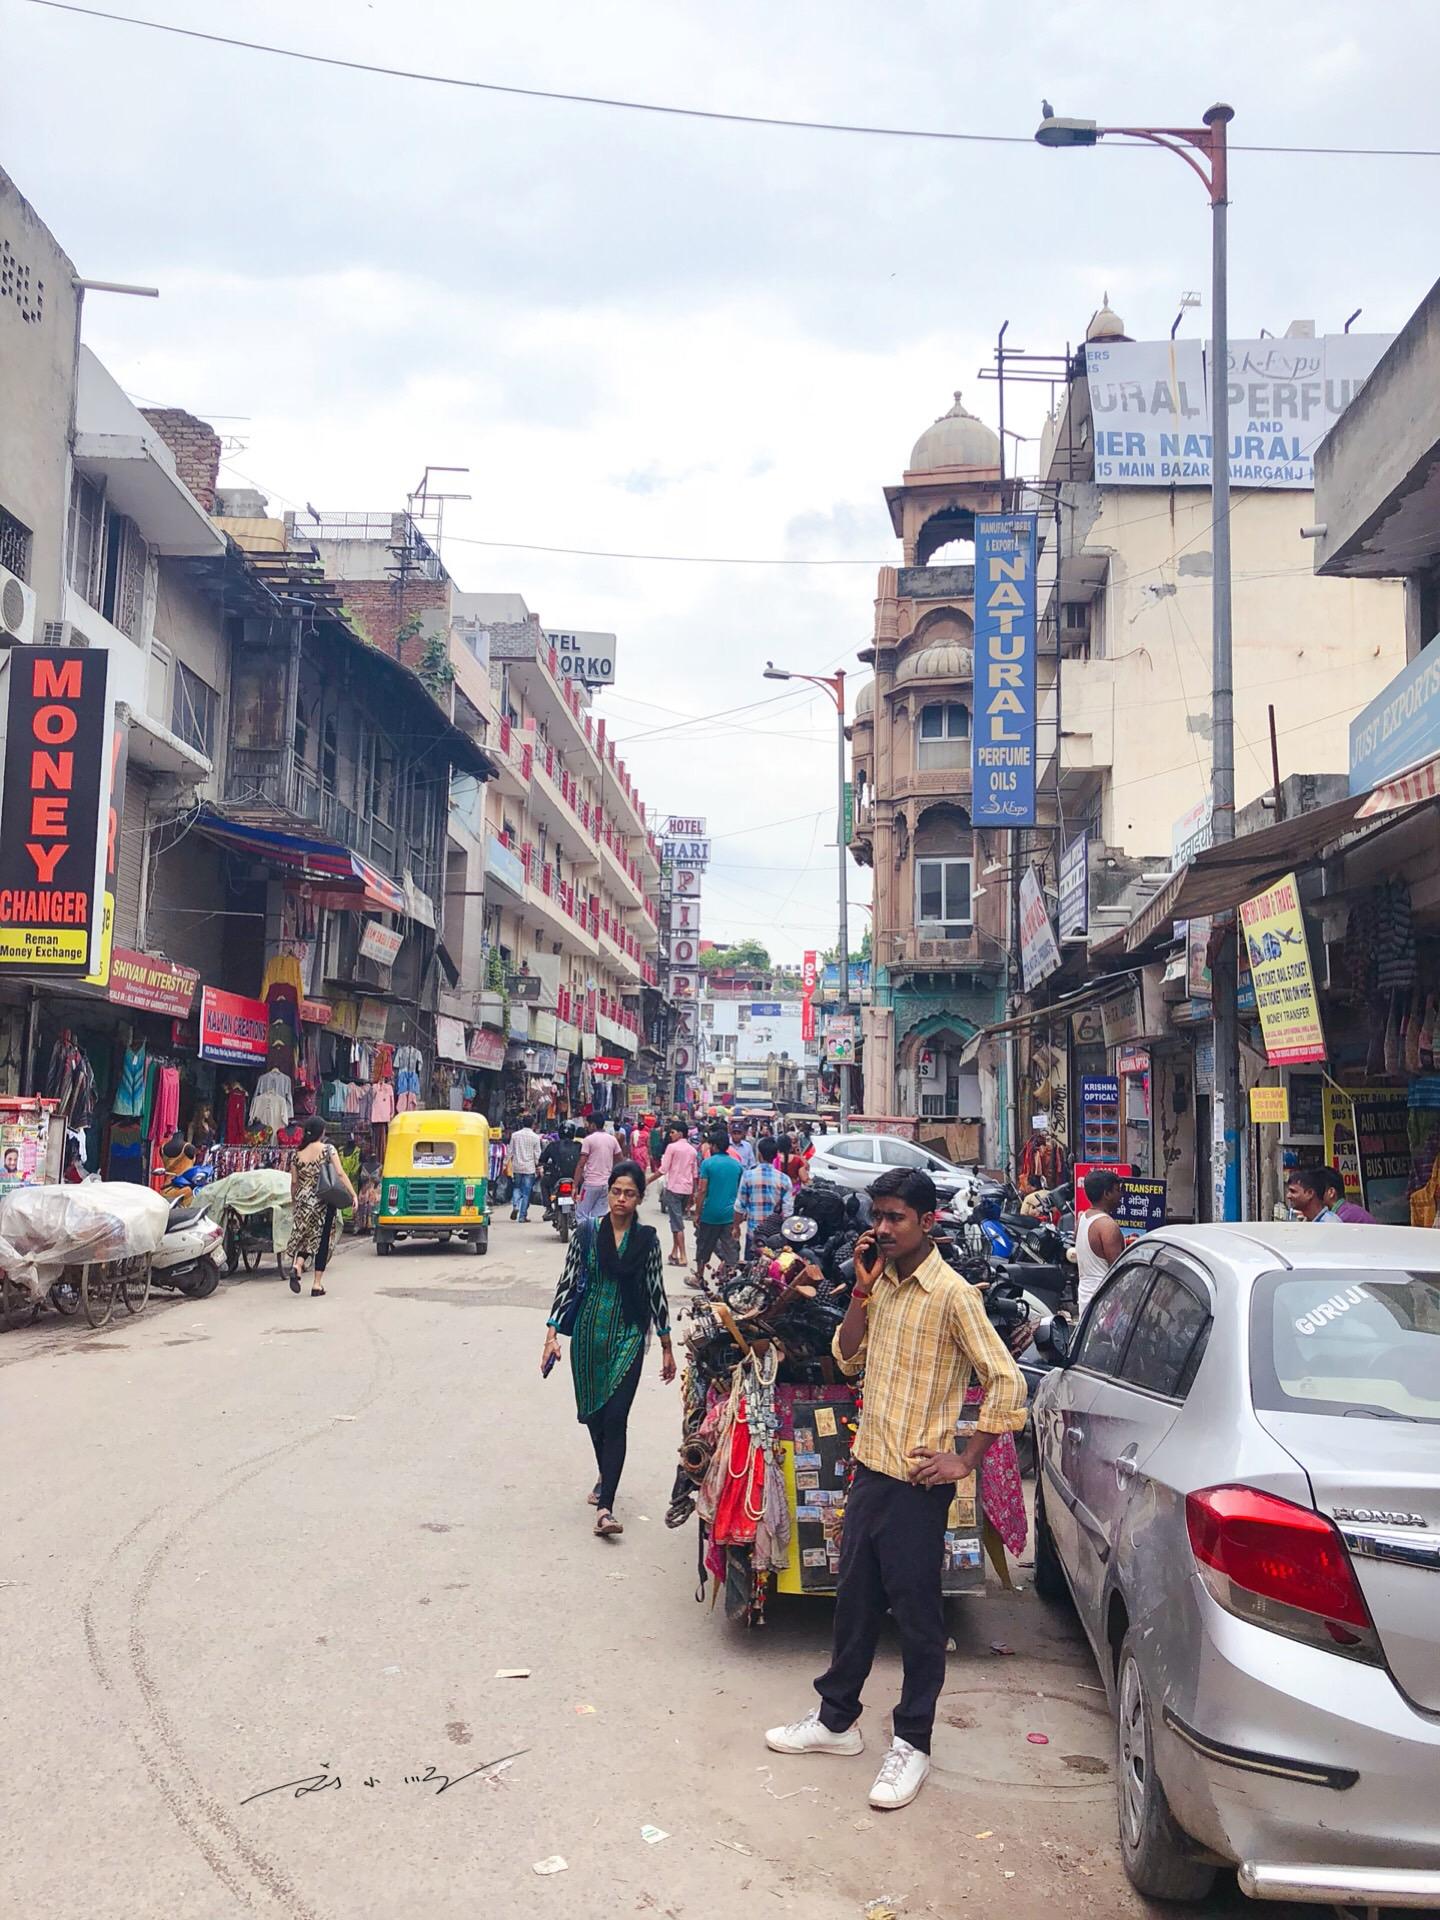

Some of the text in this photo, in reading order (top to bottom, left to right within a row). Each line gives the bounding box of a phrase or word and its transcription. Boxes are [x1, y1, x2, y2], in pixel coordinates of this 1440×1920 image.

[1248, 421, 1284, 433] AND
[1119, 462, 1156, 477] MAIN
[1161, 463, 1211, 477] BAZAR
[986, 556, 1026, 741] NATURAL
[1352, 716, 1380, 768] JUST
[978, 747, 1030, 767] PERFUME
[25, 659, 83, 882] MONEY
[990, 771, 1017, 791] OILS
[669, 819, 703, 833] HOTEL
[663, 842, 709, 859] HARI
[0, 889, 87, 923] CHANGER
[25, 933, 58, 945] Reman
[0, 945, 82, 960] Money Exchange
[112, 959, 148, 984] SHIVAM
[147, 969, 195, 996] INTERSTYLE
[805, 962, 815, 987] OYO
[1266, 1006, 1310, 1024] MONEY TRANSFER
[207, 1008, 267, 1042] KALYAN CREATIONS
[1084, 1083, 1117, 1091] KRISHNA
[1252, 1090, 1284, 1099] NEW
[1255, 1100, 1284, 1109] SIM
[1366, 1159, 1381, 1177] BUS
[1125, 1183, 1164, 1195] TRANSFER
[1130, 1220, 1146, 1228] TICKET
[1295, 1285, 1370, 1335] GURUJI
[1331, 1506, 1429, 1528] HONDA
